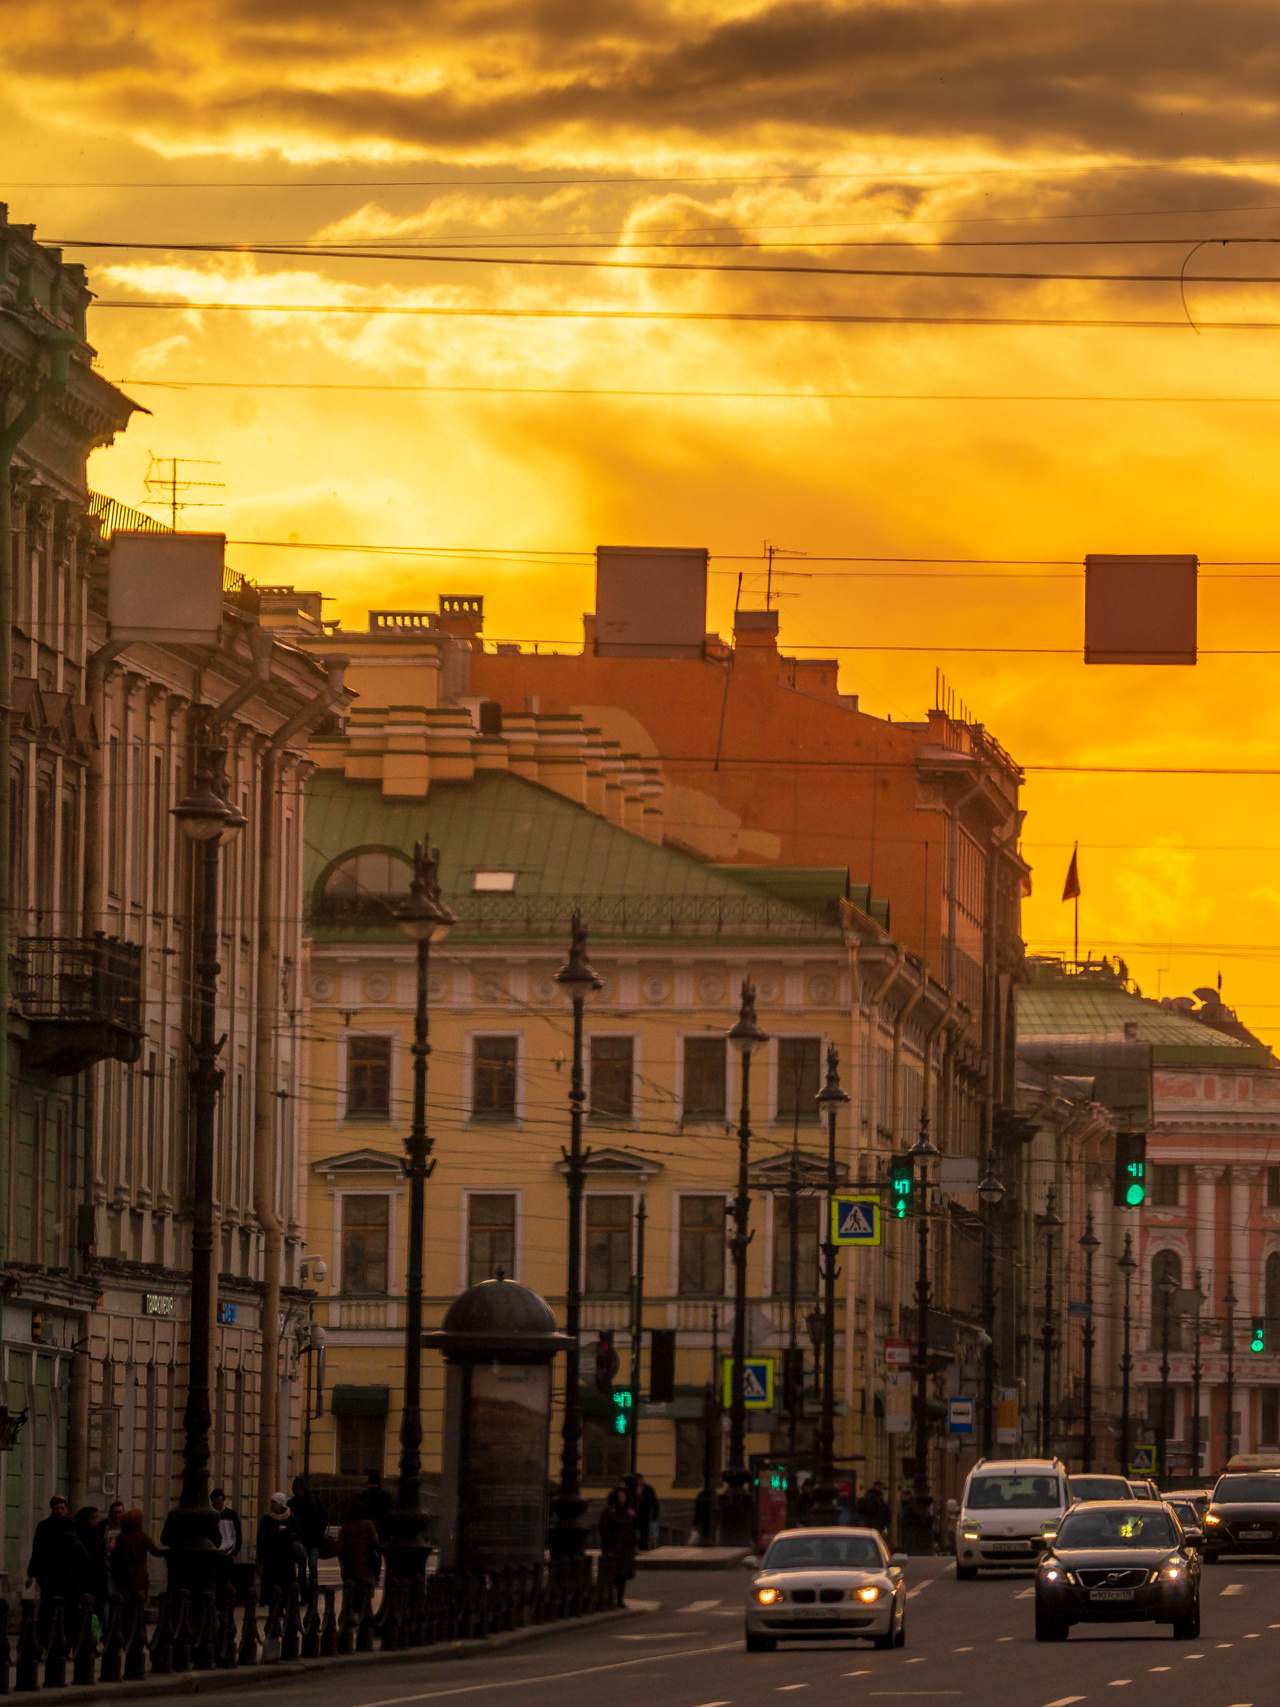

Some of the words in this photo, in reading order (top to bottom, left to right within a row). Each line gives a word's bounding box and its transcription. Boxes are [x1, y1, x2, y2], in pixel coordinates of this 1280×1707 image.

[1127, 1162, 1143, 1177] 41
[894, 1179, 910, 1194] 47
[613, 1391, 632, 1407] 47
